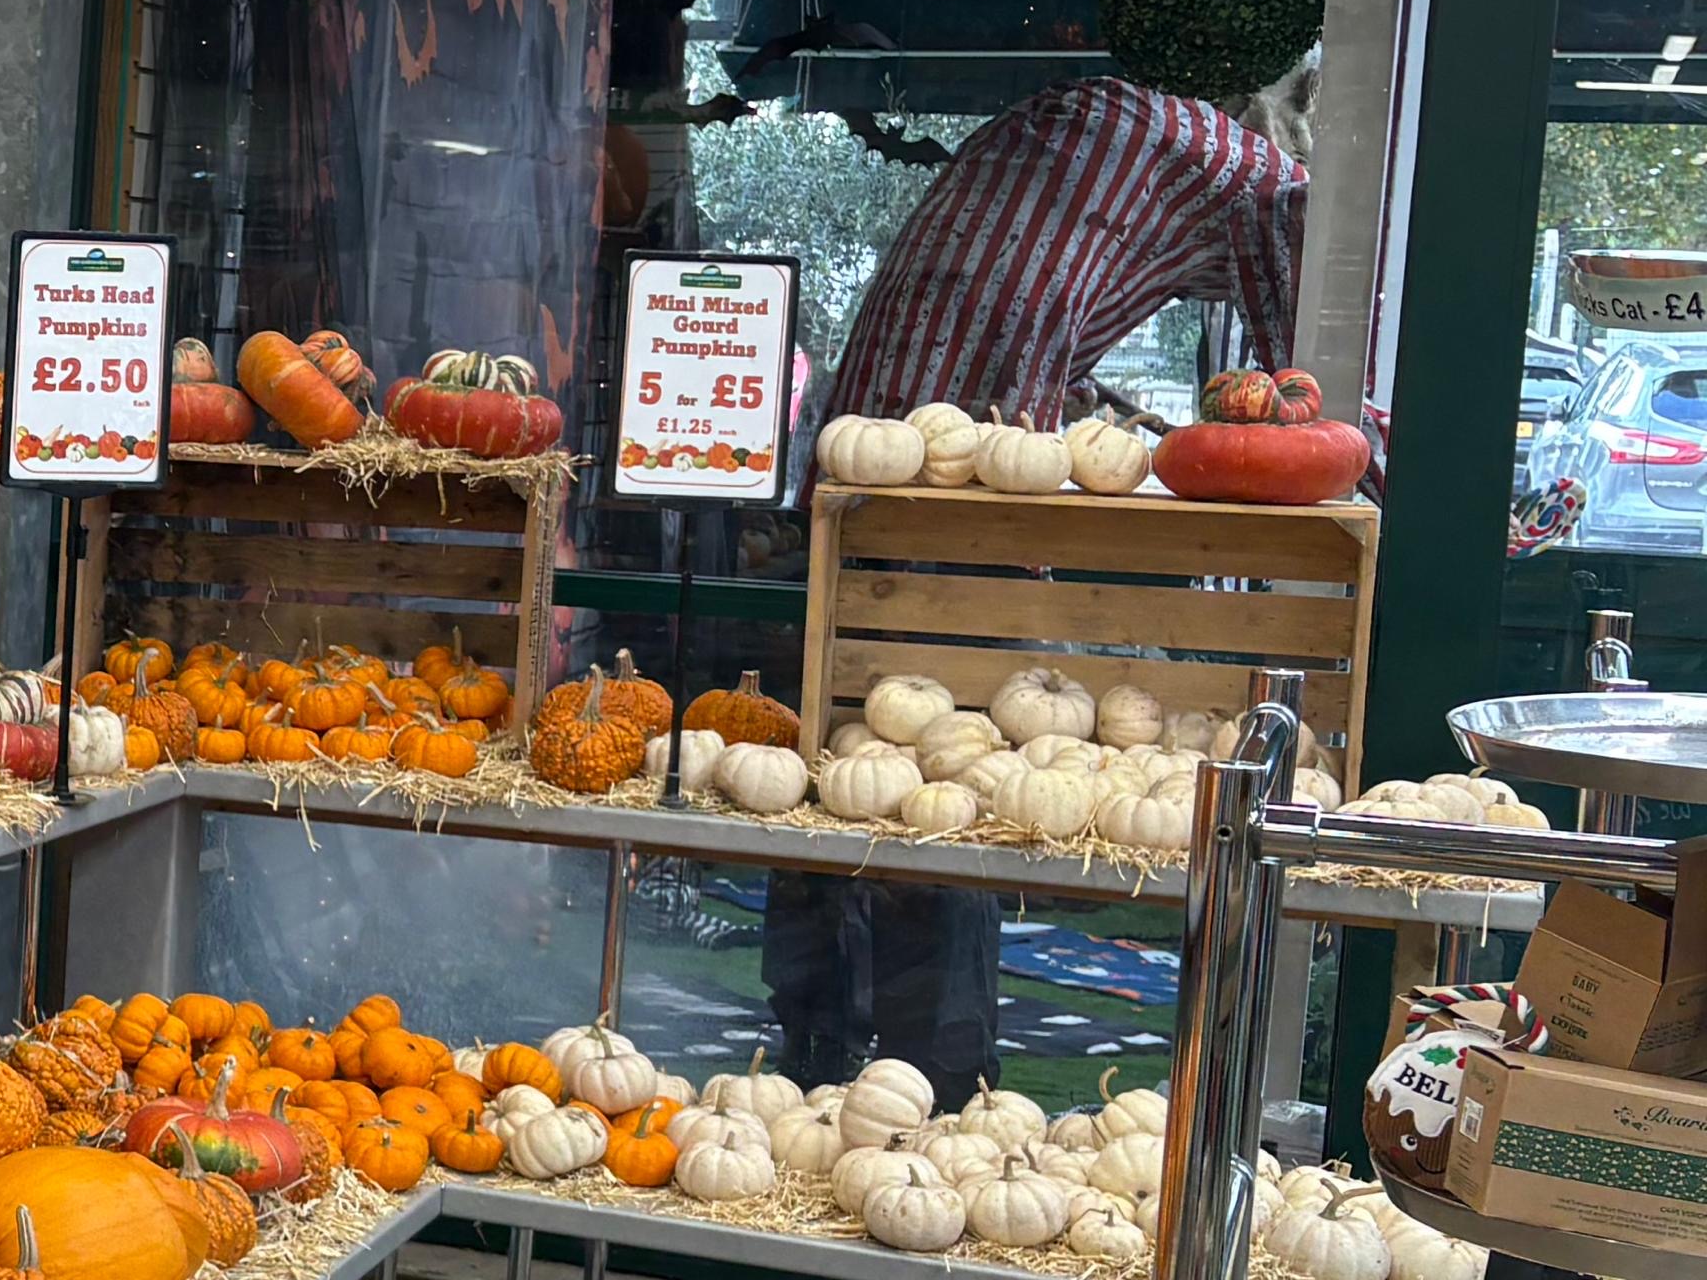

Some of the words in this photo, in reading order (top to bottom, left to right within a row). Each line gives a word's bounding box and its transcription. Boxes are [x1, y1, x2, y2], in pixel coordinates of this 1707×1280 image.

[34, 284, 95, 303] Turks
[102, 286, 154, 304] Head
[647, 295, 694, 312] Mini
[702, 296, 768, 314] Mixed
[1612, 298, 1648, 321] Cat
[39, 317, 147, 340] Pumpkins
[673, 317, 738, 334] Gourd
[652, 338, 756, 359] Pumpkins
[33, 358, 147, 392] £2.50
[638, 372, 662, 404] 5
[677, 394, 698, 406] for
[710, 374, 763, 409] £5
[657, 418, 712, 435] £1.25
[1393, 1063, 1457, 1107] BEL
